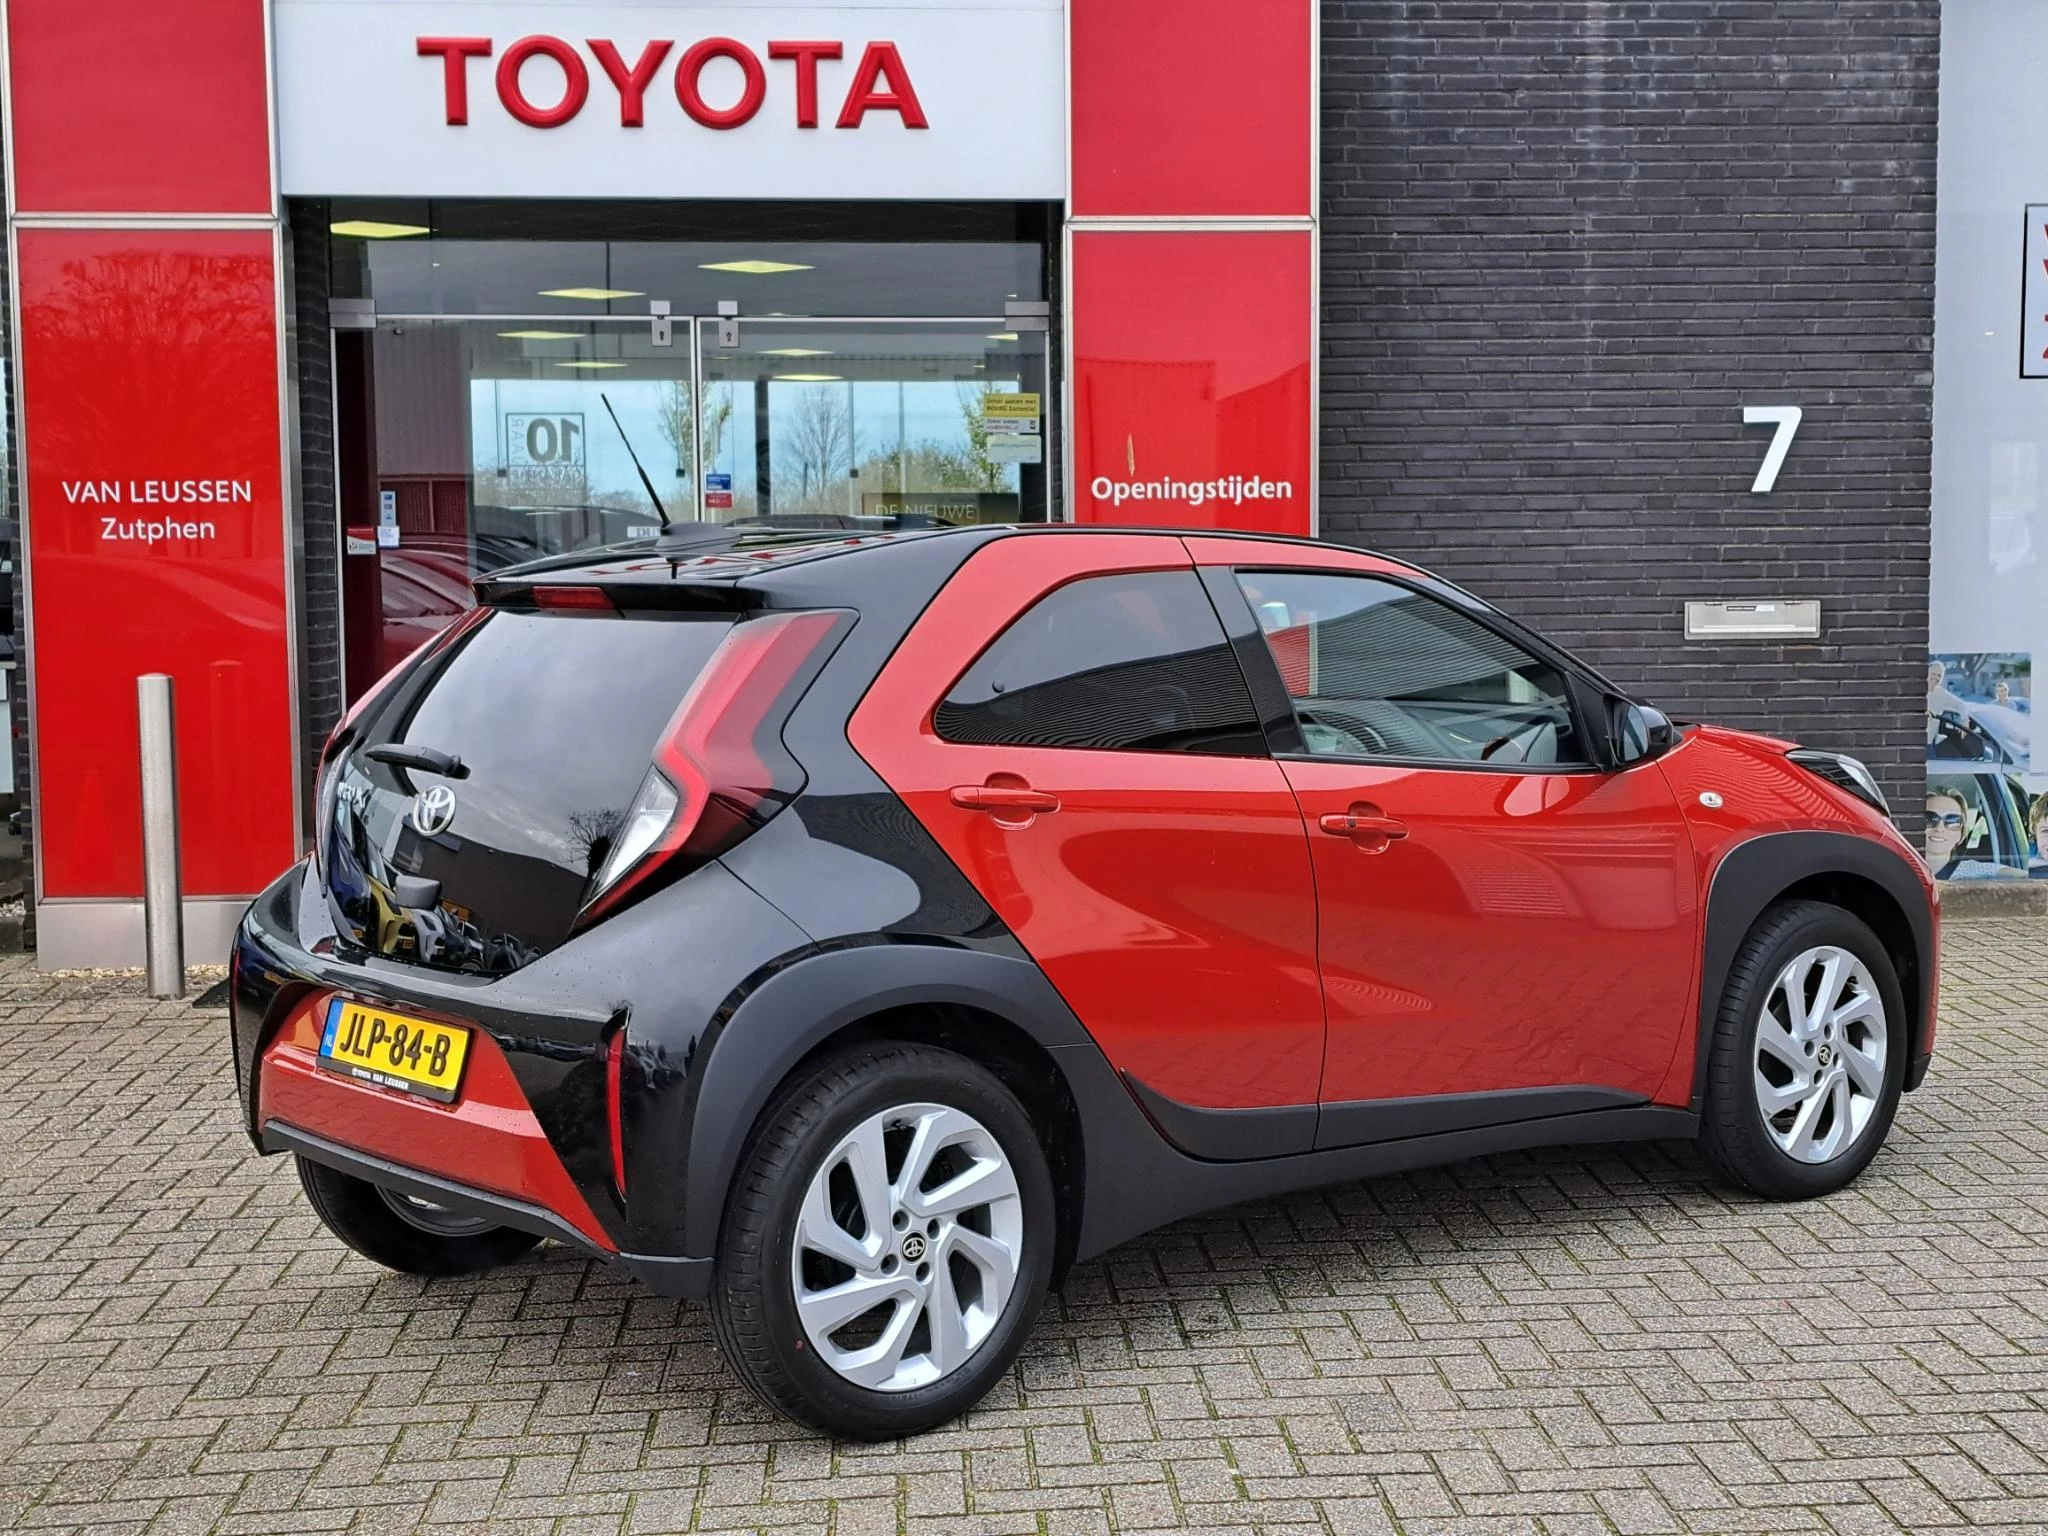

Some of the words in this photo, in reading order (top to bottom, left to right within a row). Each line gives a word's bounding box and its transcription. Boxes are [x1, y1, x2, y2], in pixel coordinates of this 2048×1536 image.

[416, 35, 930, 130] TOYOTA
[1743, 406, 1803, 493] 7
[62, 480, 121, 503] VAN
[130, 480, 252, 503] LEUSSEN
[1091, 475, 1292, 506] Openingstijden
[100, 515, 215, 545] Zutphen
[339, 1012, 451, 1077] JLP-84-B
